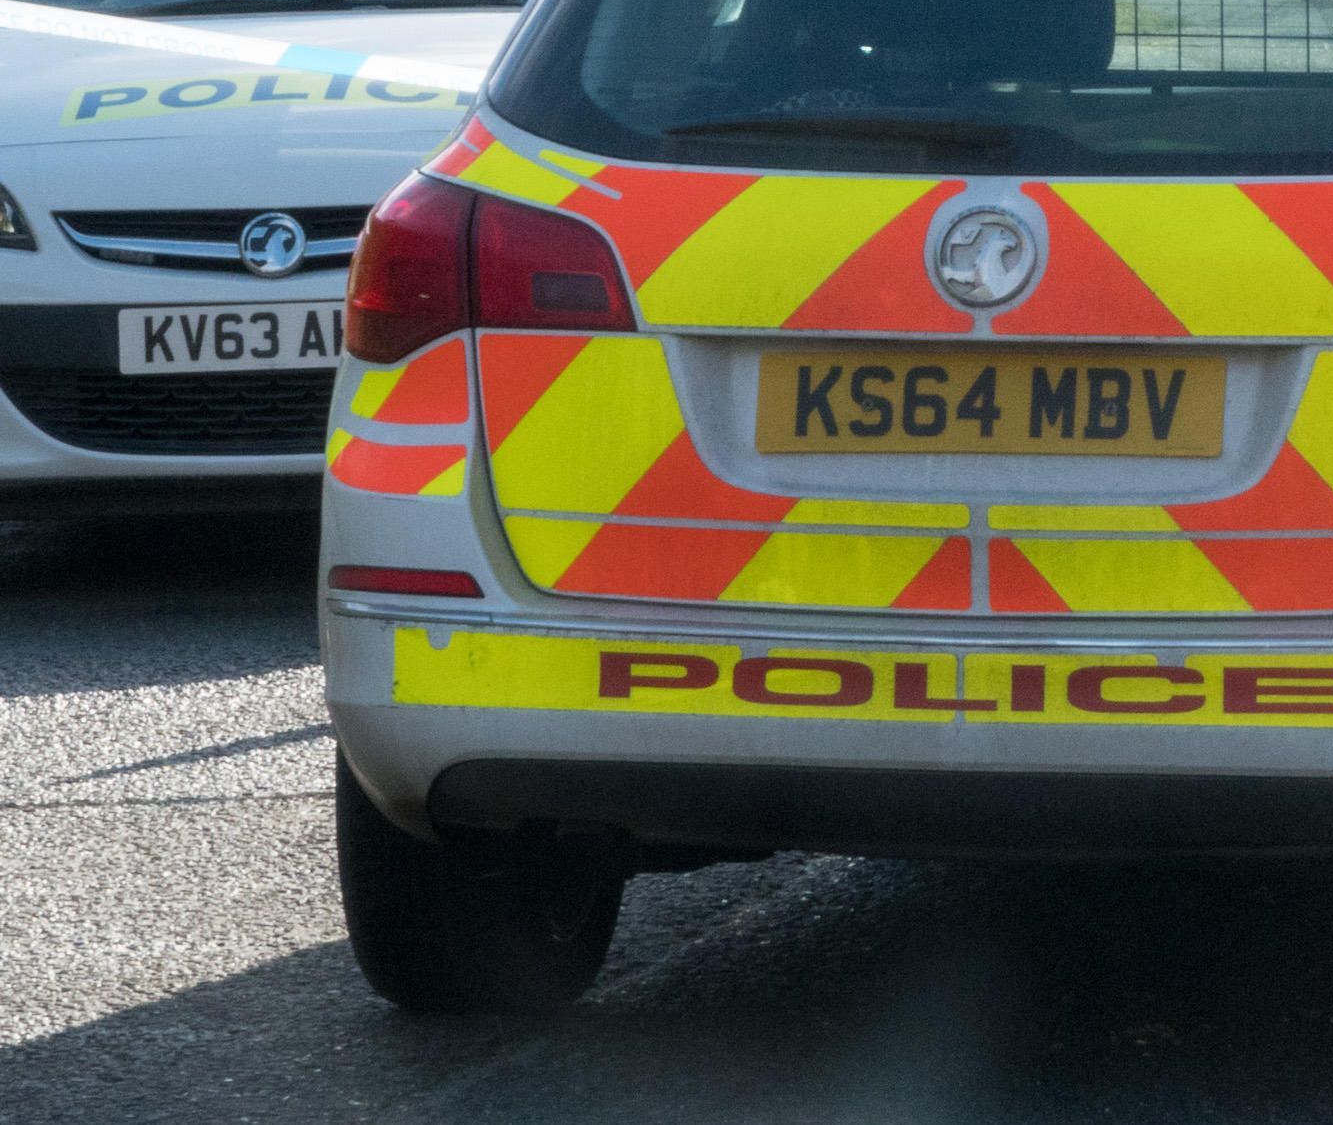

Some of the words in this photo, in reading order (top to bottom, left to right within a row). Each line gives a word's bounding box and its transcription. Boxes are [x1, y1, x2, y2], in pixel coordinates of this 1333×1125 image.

[74, 74, 478, 120] POLIC
[144, 311, 280, 363] KV63
[794, 365, 1001, 439] KS64
[1028, 366, 1187, 441] MBV
